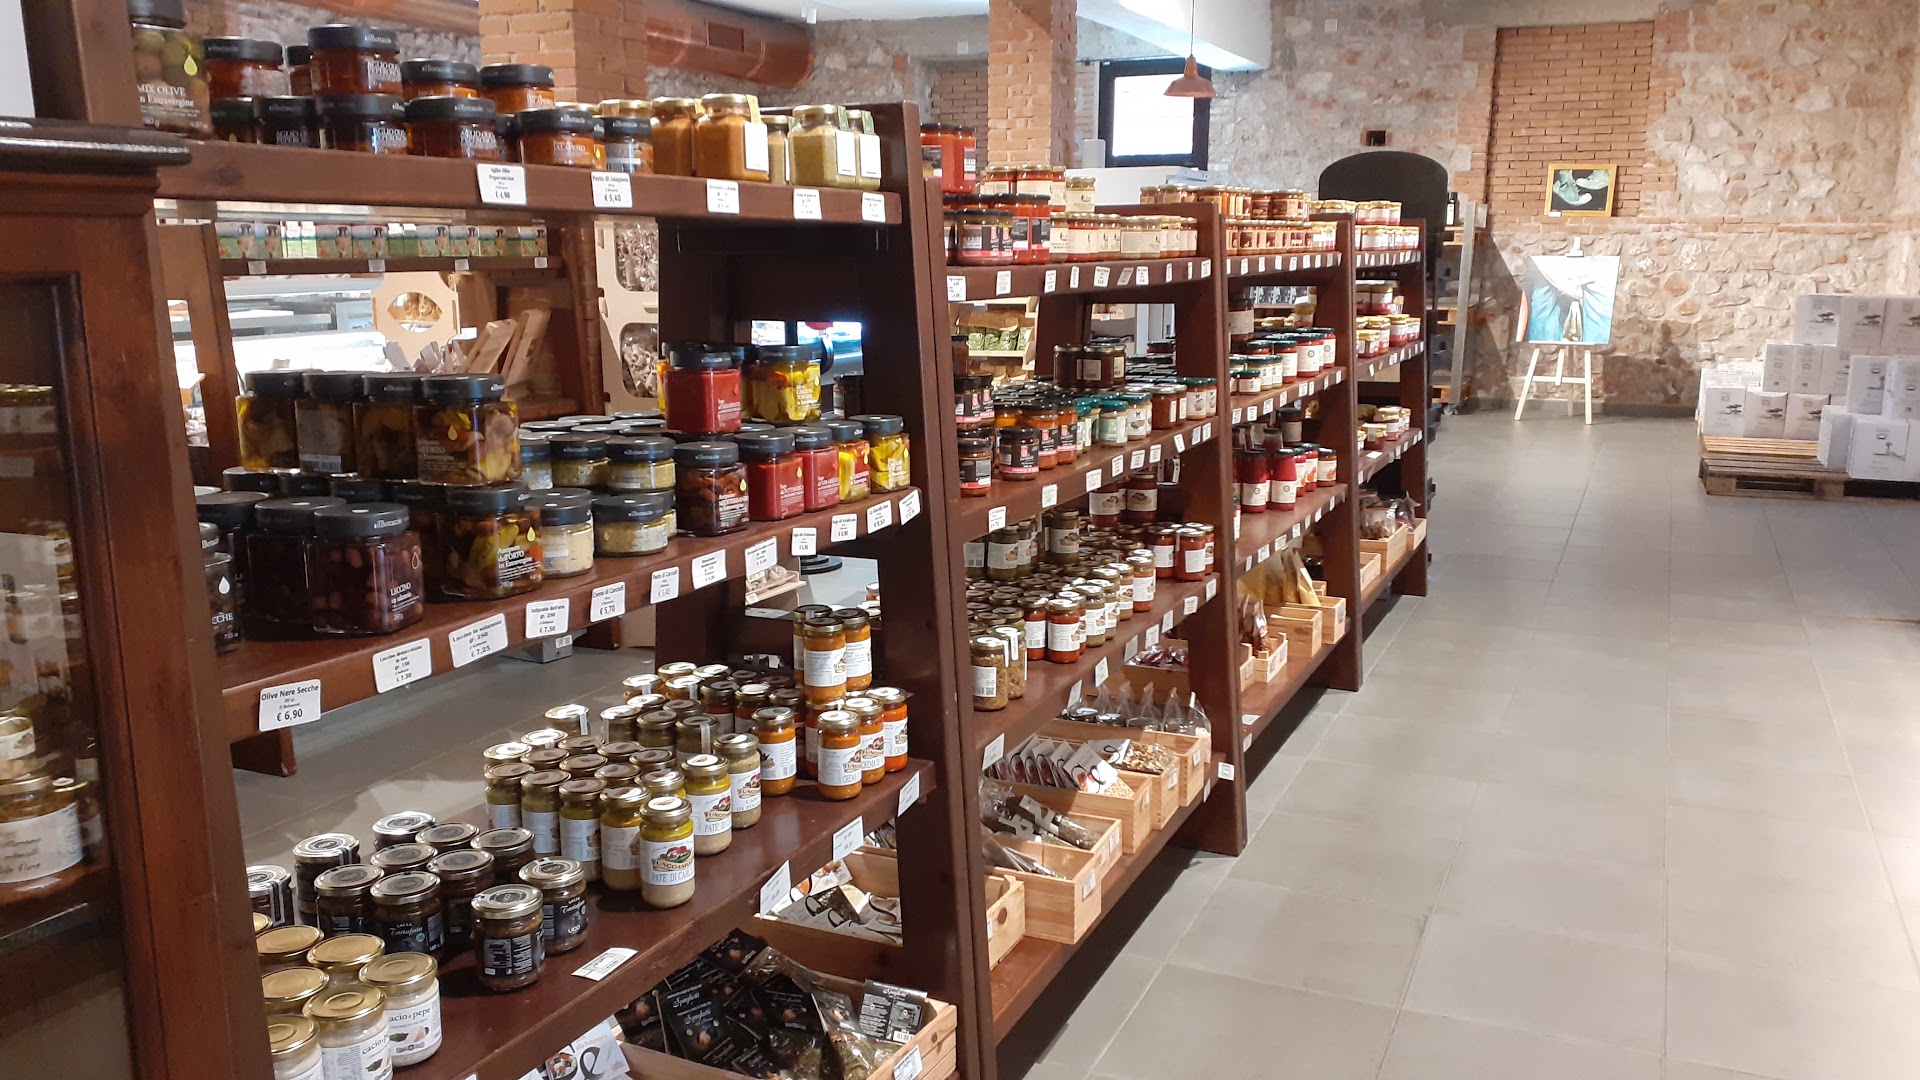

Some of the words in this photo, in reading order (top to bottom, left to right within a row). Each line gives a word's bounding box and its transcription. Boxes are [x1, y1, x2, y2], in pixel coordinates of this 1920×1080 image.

[156, 85, 187, 96] OLIVE
[212, 612, 233, 625] CCHE
[261, 692, 278, 701] Olive
[280, 689, 295, 698] Nere
[297, 684, 319, 695] Secche
[277, 712, 282, 721] €
[284, 709, 303, 721] 6,90
[389, 1013, 408, 1022] acio
[412, 1008, 431, 1020] pepe
